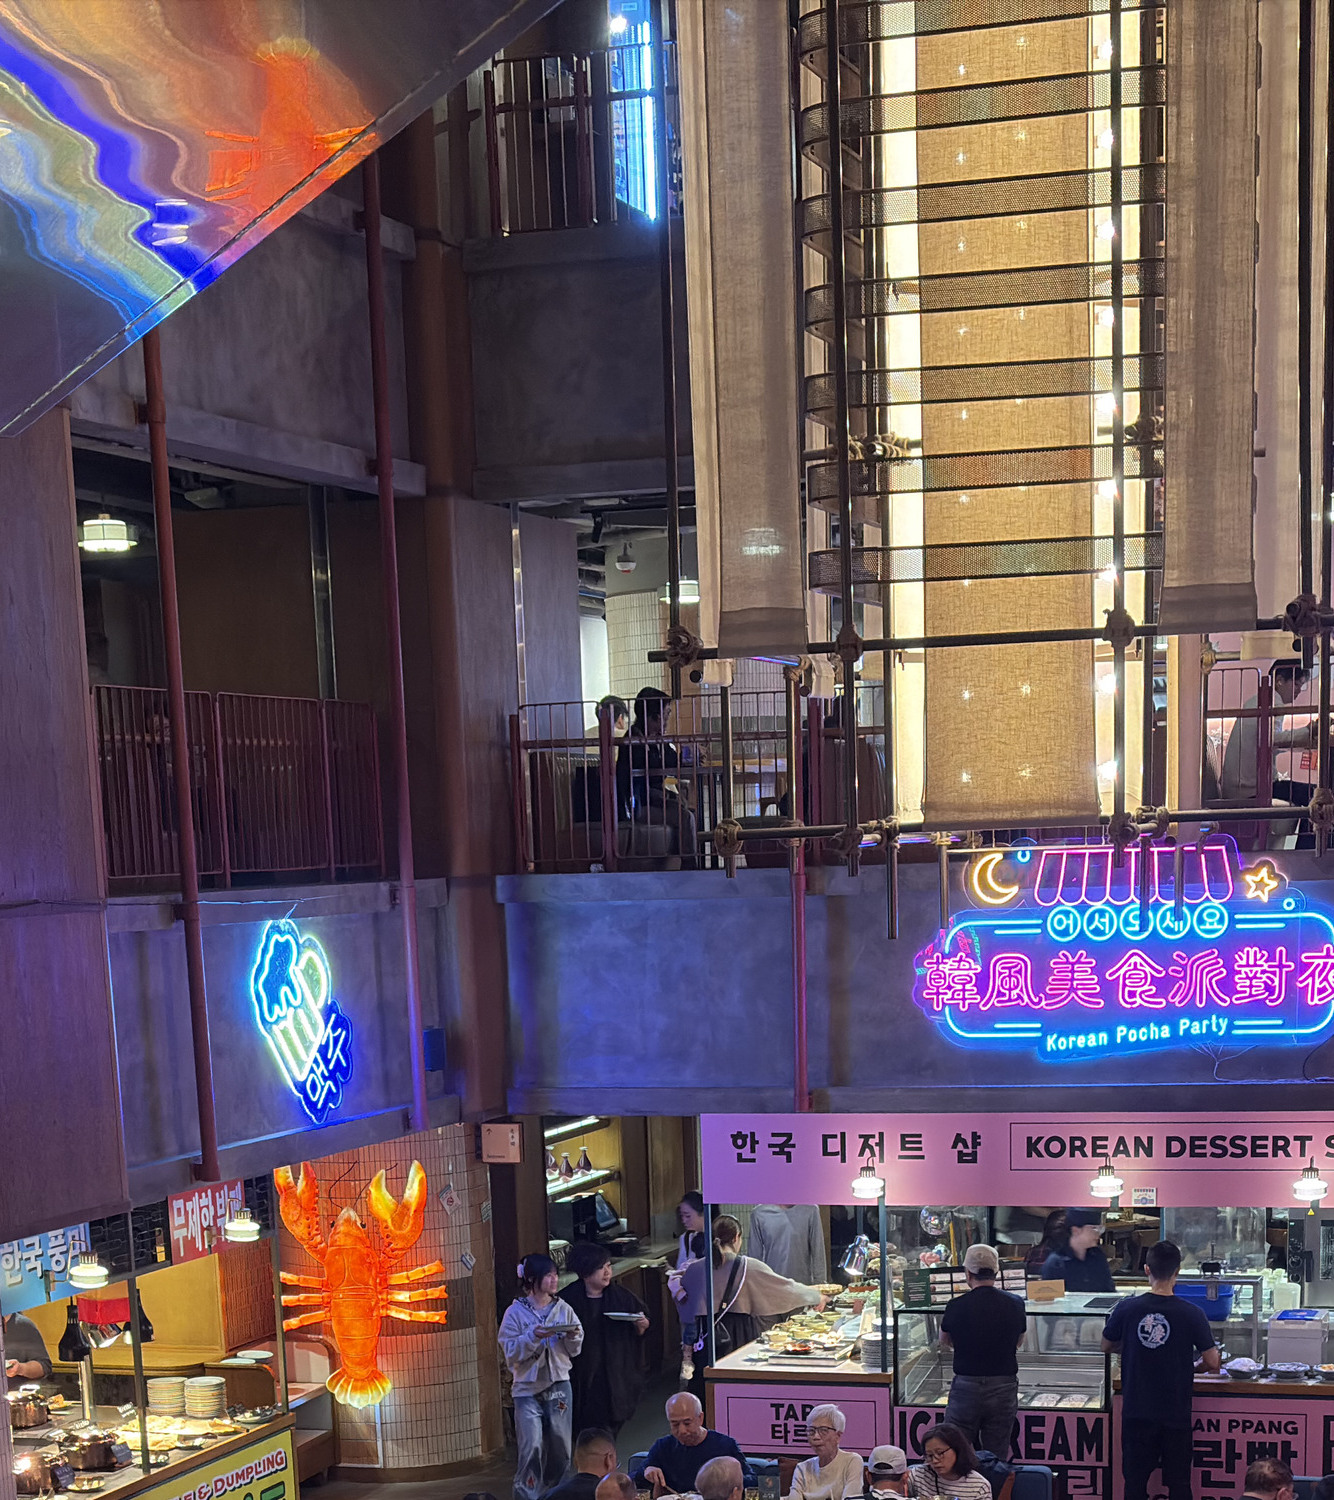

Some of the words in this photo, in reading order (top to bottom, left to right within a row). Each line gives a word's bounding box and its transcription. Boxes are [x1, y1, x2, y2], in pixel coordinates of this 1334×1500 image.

[1046, 1032, 1108, 1052] Korean
[1116, 1024, 1170, 1044] Pocha
[1179, 1015, 1229, 1036] Party
[730, 1131, 797, 1164] 한국
[821, 1131, 926, 1164] 디저트
[950, 1131, 982, 1164] 샵
[1025, 1135, 1154, 1159] KOREAN
[1165, 1135, 1313, 1159] DESSERT
[0, 1235, 43, 1287] 한국
[770, 1424, 809, 1444] 타르
[1228, 1418, 1299, 1436] PPANG
[213, 1449, 287, 1498] DUMPLING
